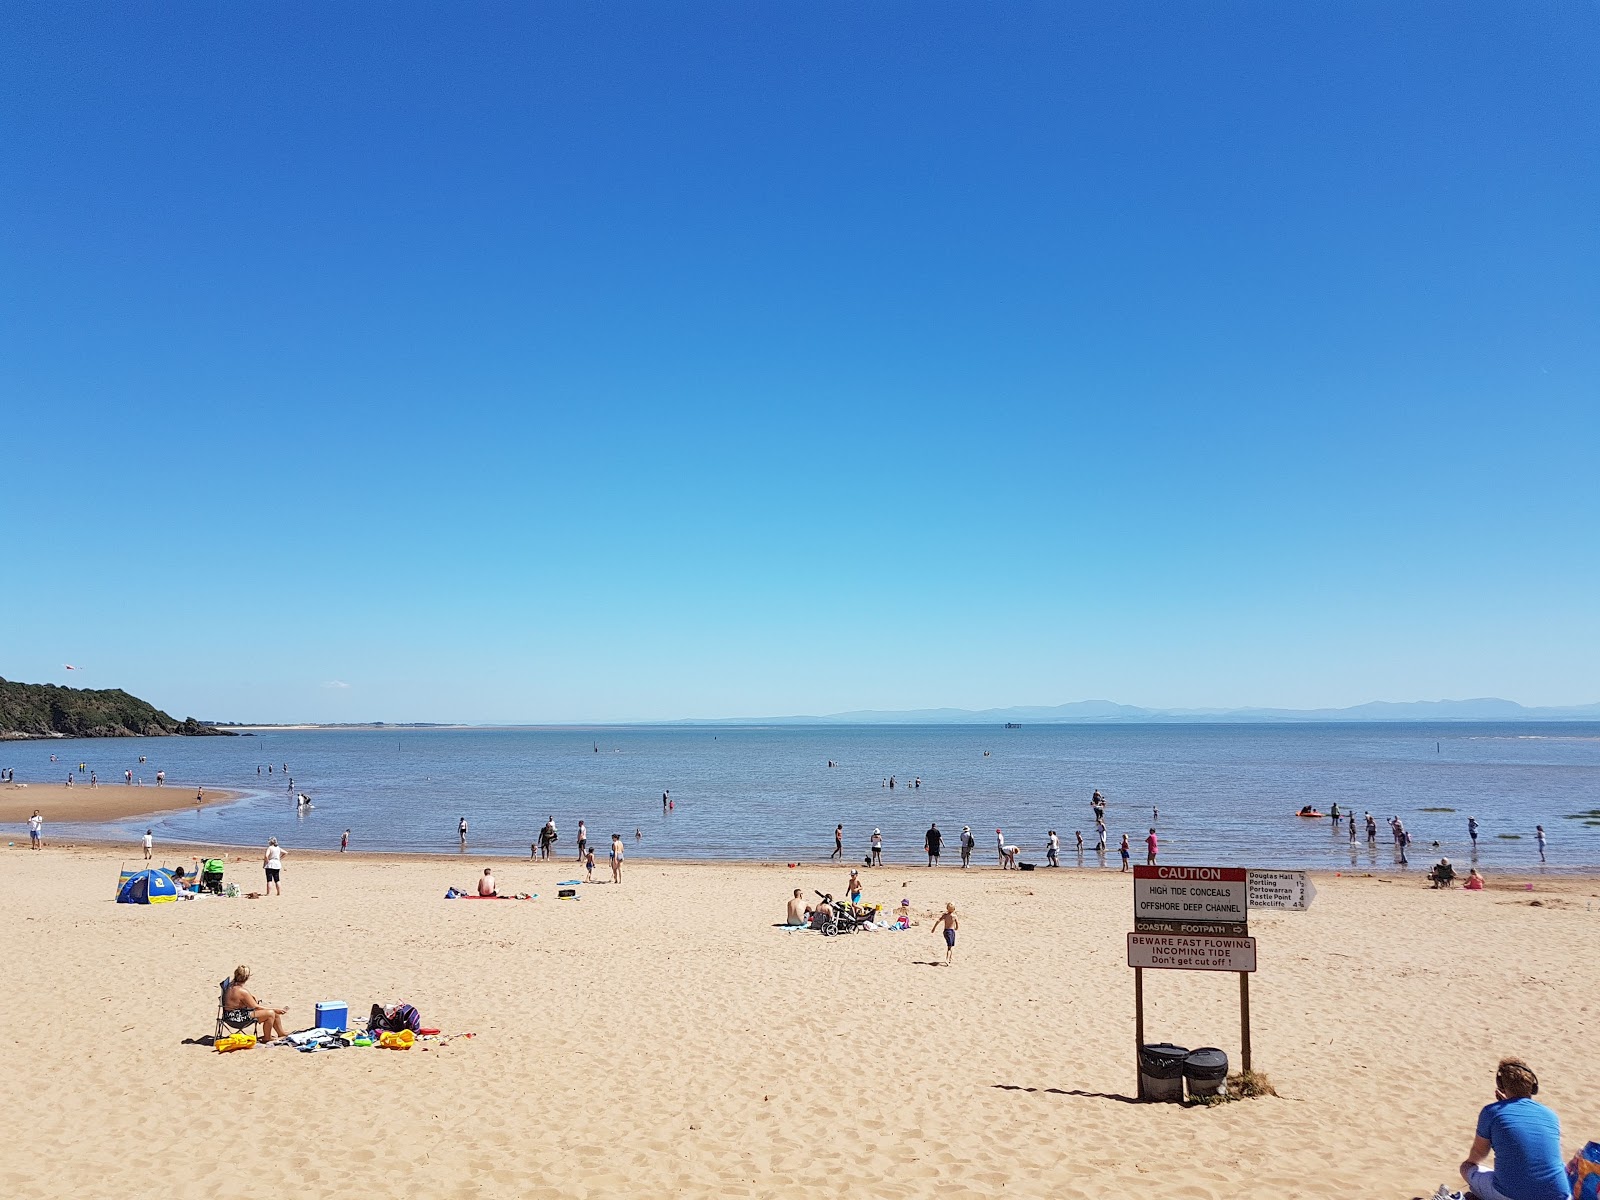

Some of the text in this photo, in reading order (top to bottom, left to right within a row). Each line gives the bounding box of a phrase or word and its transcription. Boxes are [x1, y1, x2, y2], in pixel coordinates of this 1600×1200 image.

[1158, 867, 1220, 880] CAUTION
[1150, 887, 1230, 897] HIGH TIDE CONCEALS
[1141, 902, 1240, 912] OFFSHORE DEEP CHANNEL
[1137, 924, 1225, 933] COASTAL FOOTPATH
[1133, 937, 1174, 945] BEWARE
[1205, 940, 1251, 948] FLOWING
[1153, 947, 1205, 956] INCOMING
[1178, 957, 1192, 966] get
